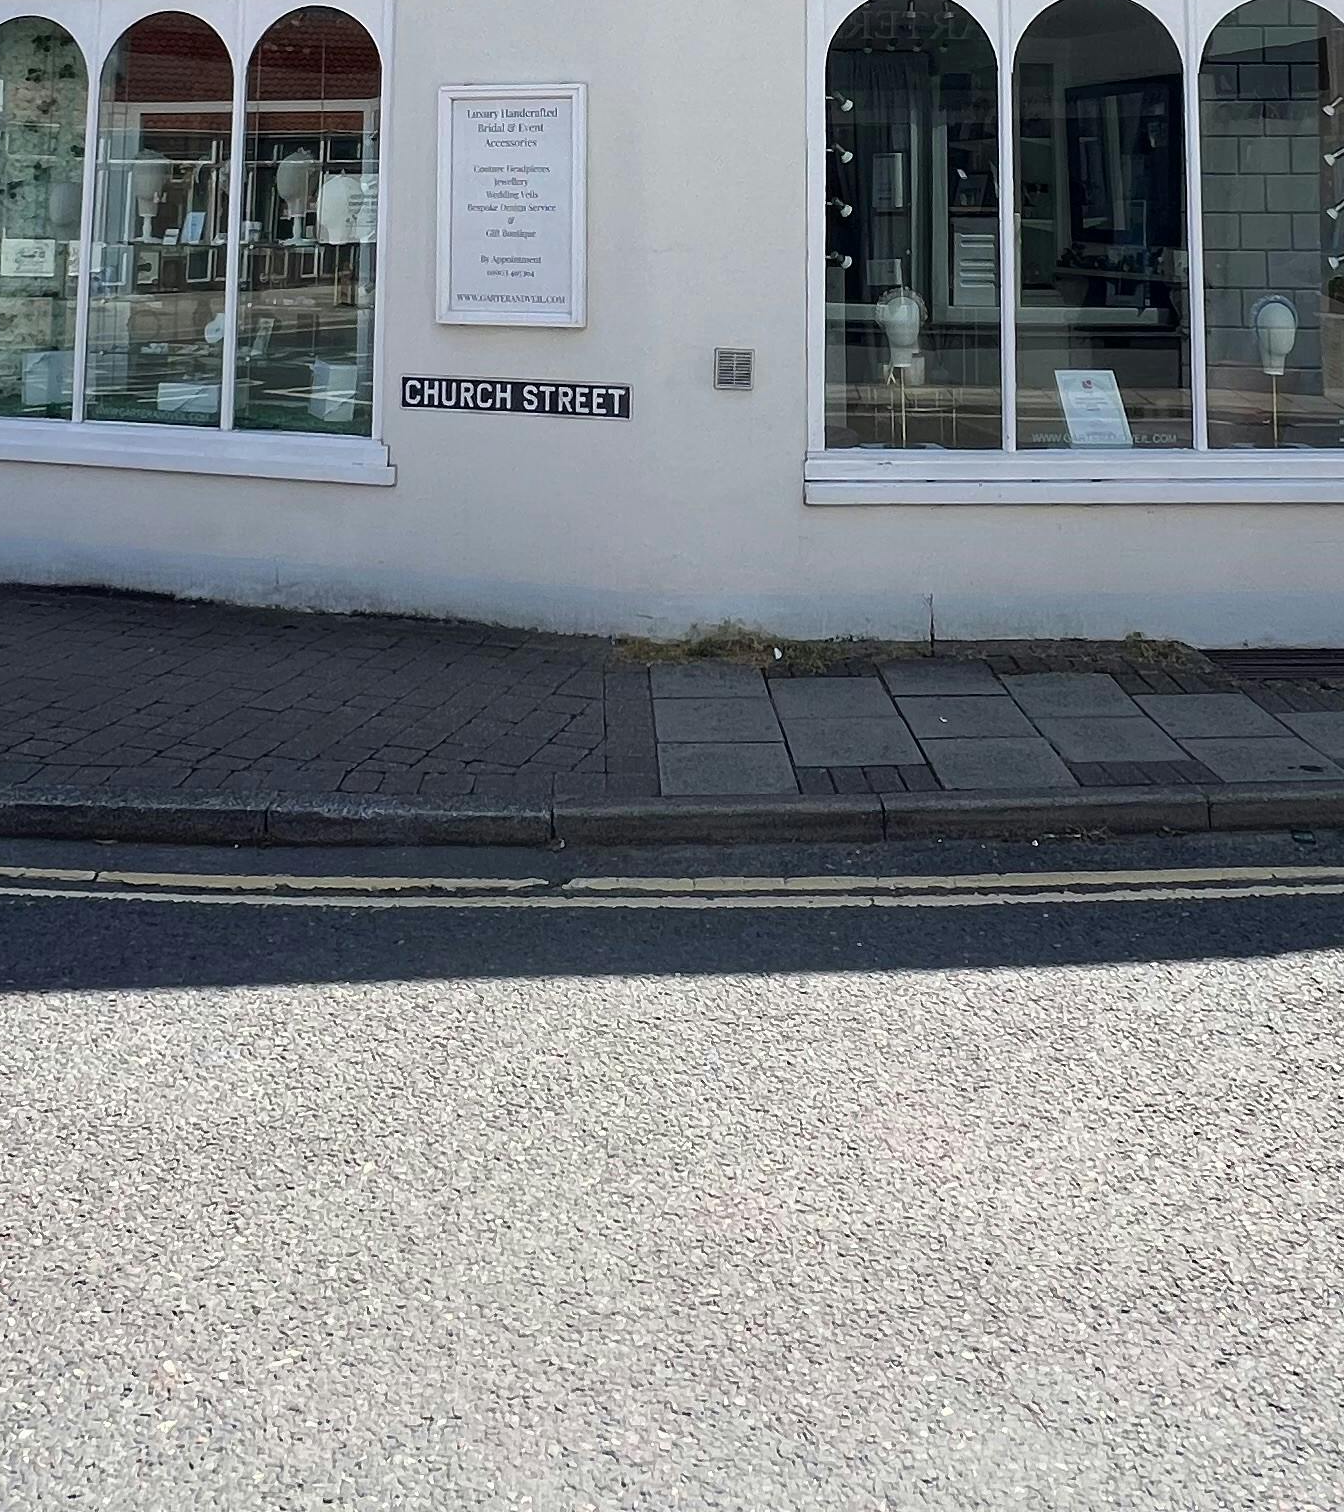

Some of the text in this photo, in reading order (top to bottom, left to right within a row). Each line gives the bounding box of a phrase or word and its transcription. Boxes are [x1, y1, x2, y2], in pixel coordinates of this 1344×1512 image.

[467, 107, 558, 120] Luxury Handcrafted
[478, 123, 544, 133] Bridal & Event
[485, 138, 537, 148] Accessories
[528, 203, 556, 212] Service
[491, 255, 542, 265] Appointment
[404, 379, 626, 416] CHURCH STREET
